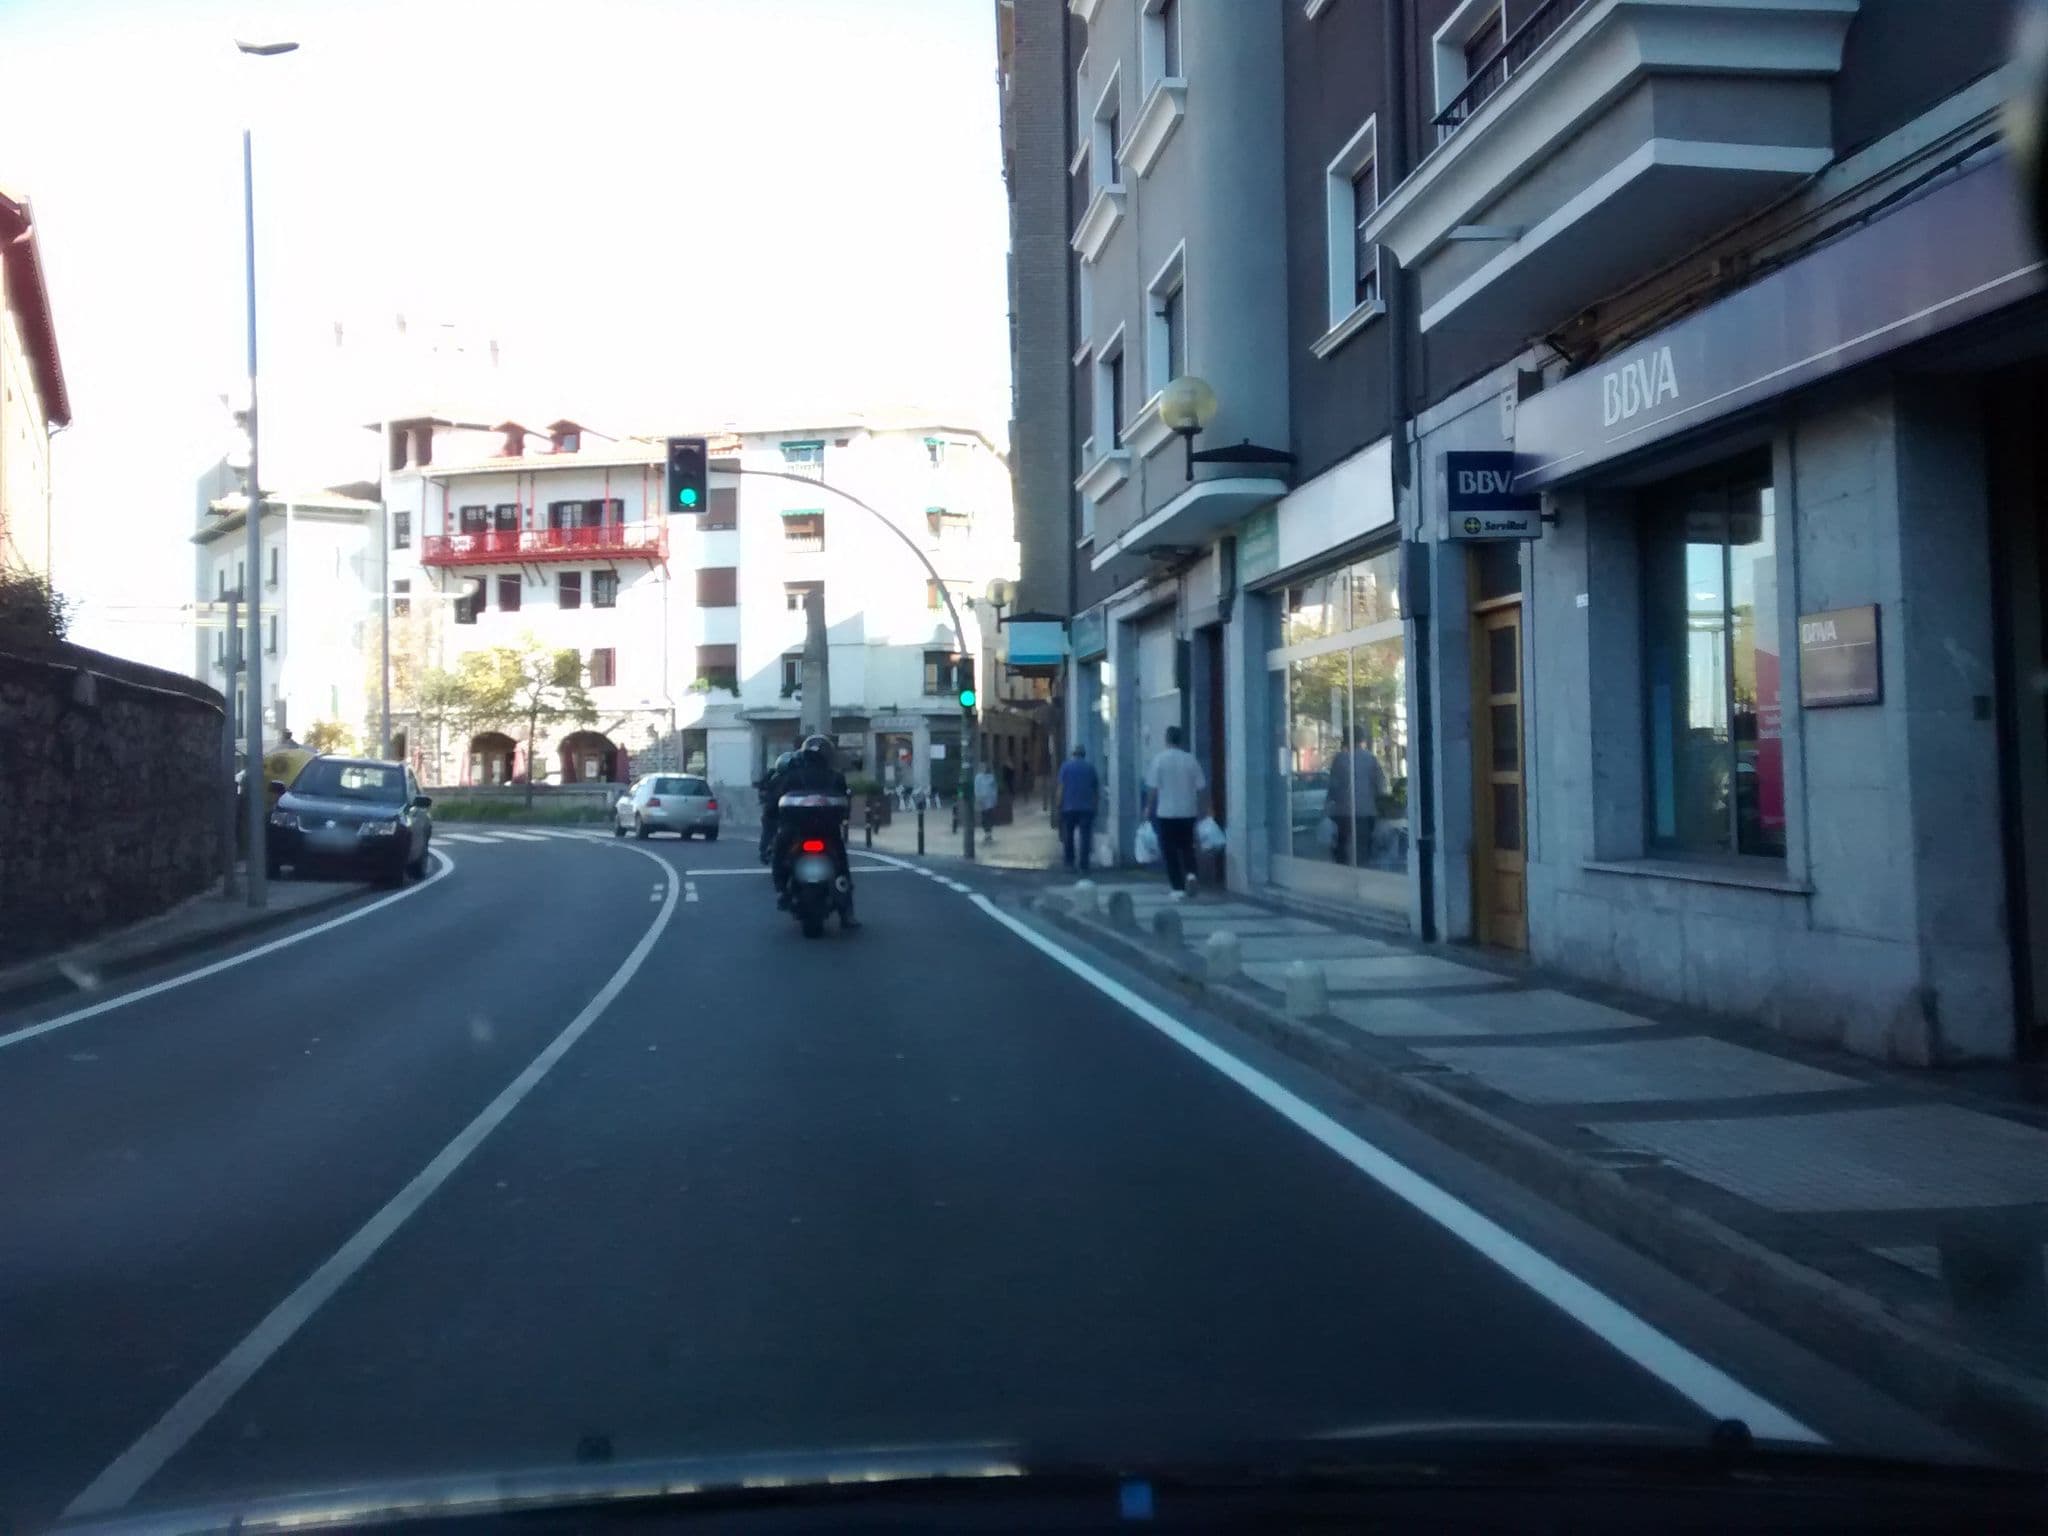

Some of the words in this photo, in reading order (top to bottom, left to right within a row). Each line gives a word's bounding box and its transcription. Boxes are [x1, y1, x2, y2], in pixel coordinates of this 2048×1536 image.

[1603, 345, 1680, 428] BBVA
[1458, 470, 1514, 494] BBV
[1485, 520, 1528, 531] ServiRed
